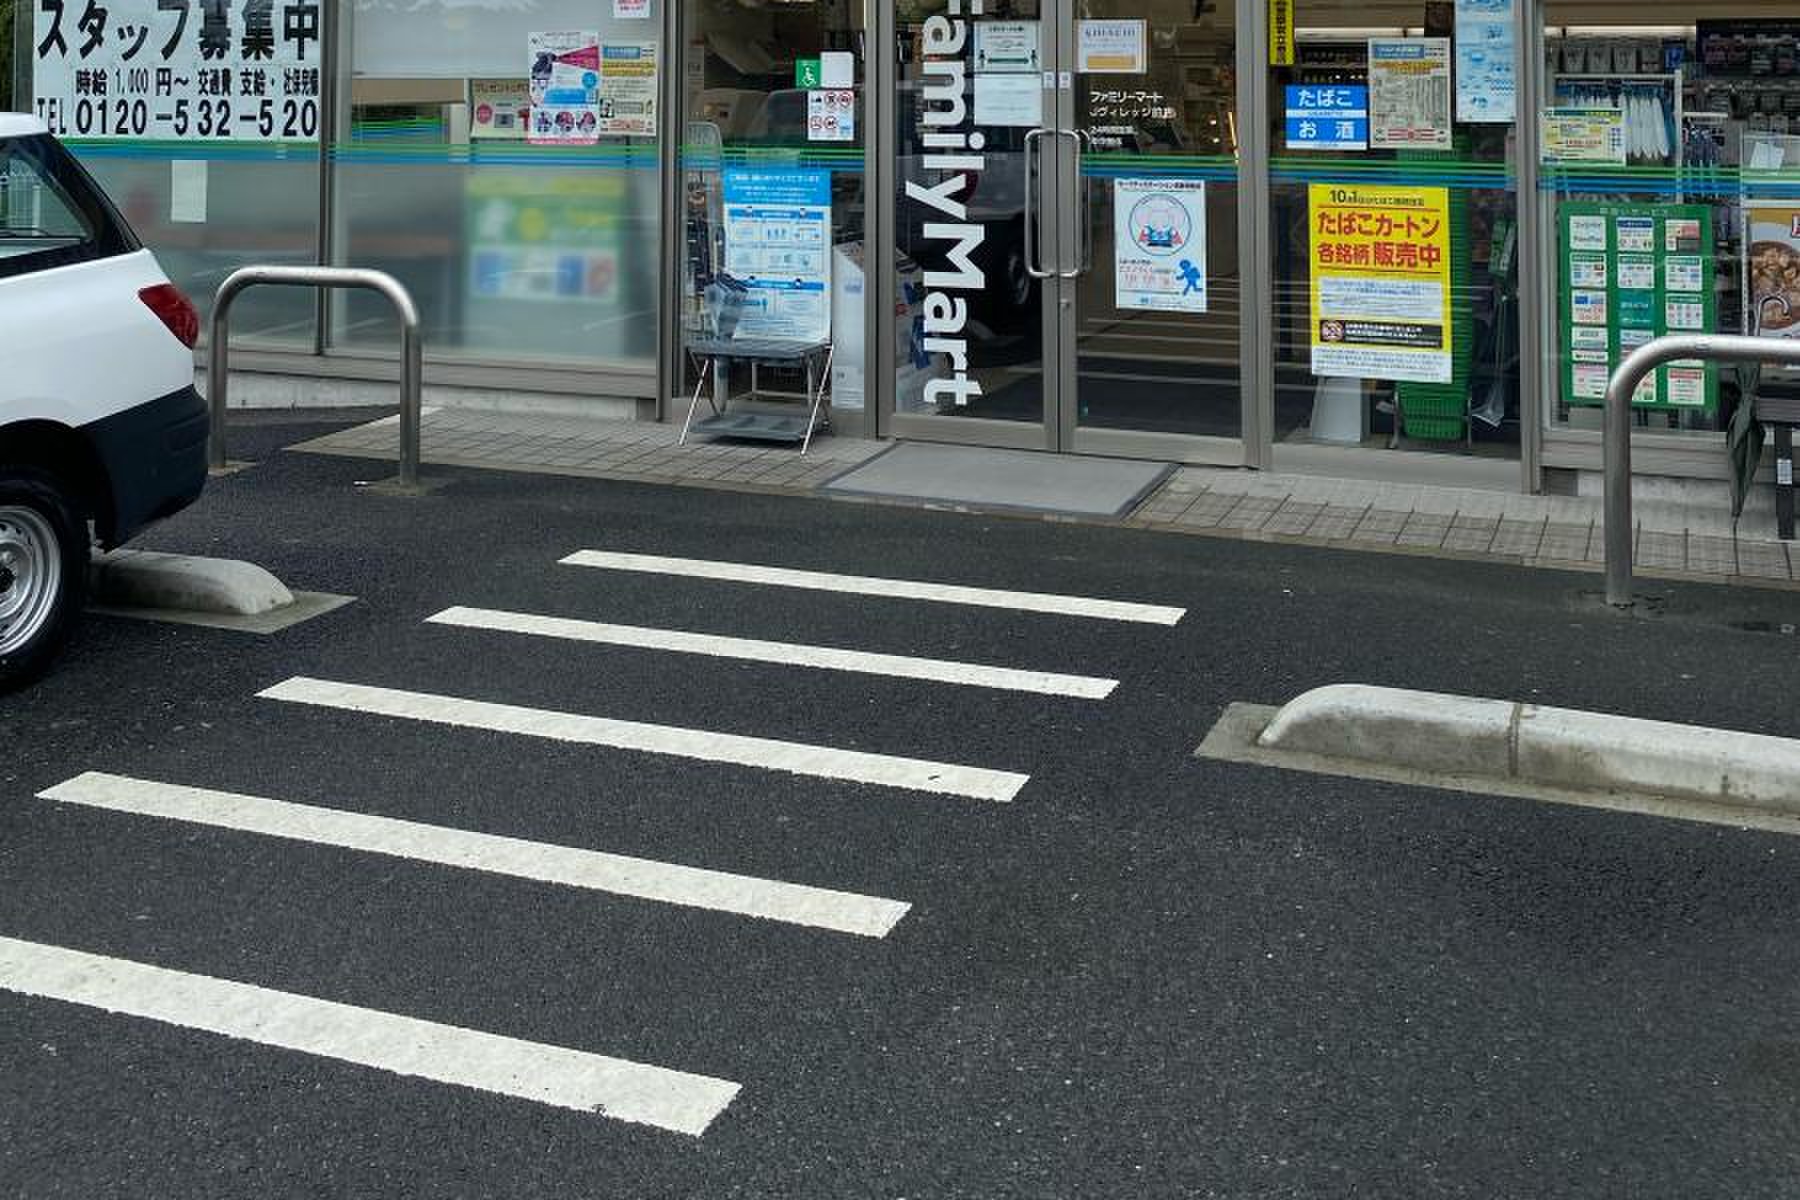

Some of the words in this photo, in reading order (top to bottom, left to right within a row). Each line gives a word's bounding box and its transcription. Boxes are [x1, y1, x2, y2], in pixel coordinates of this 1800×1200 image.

[1089, 90, 1164, 103] ファミリーマート
[1298, 89, 1354, 108] たばこ
[37, 98, 67, 134] TEL
[1317, 210, 1440, 238] たばこカートン
